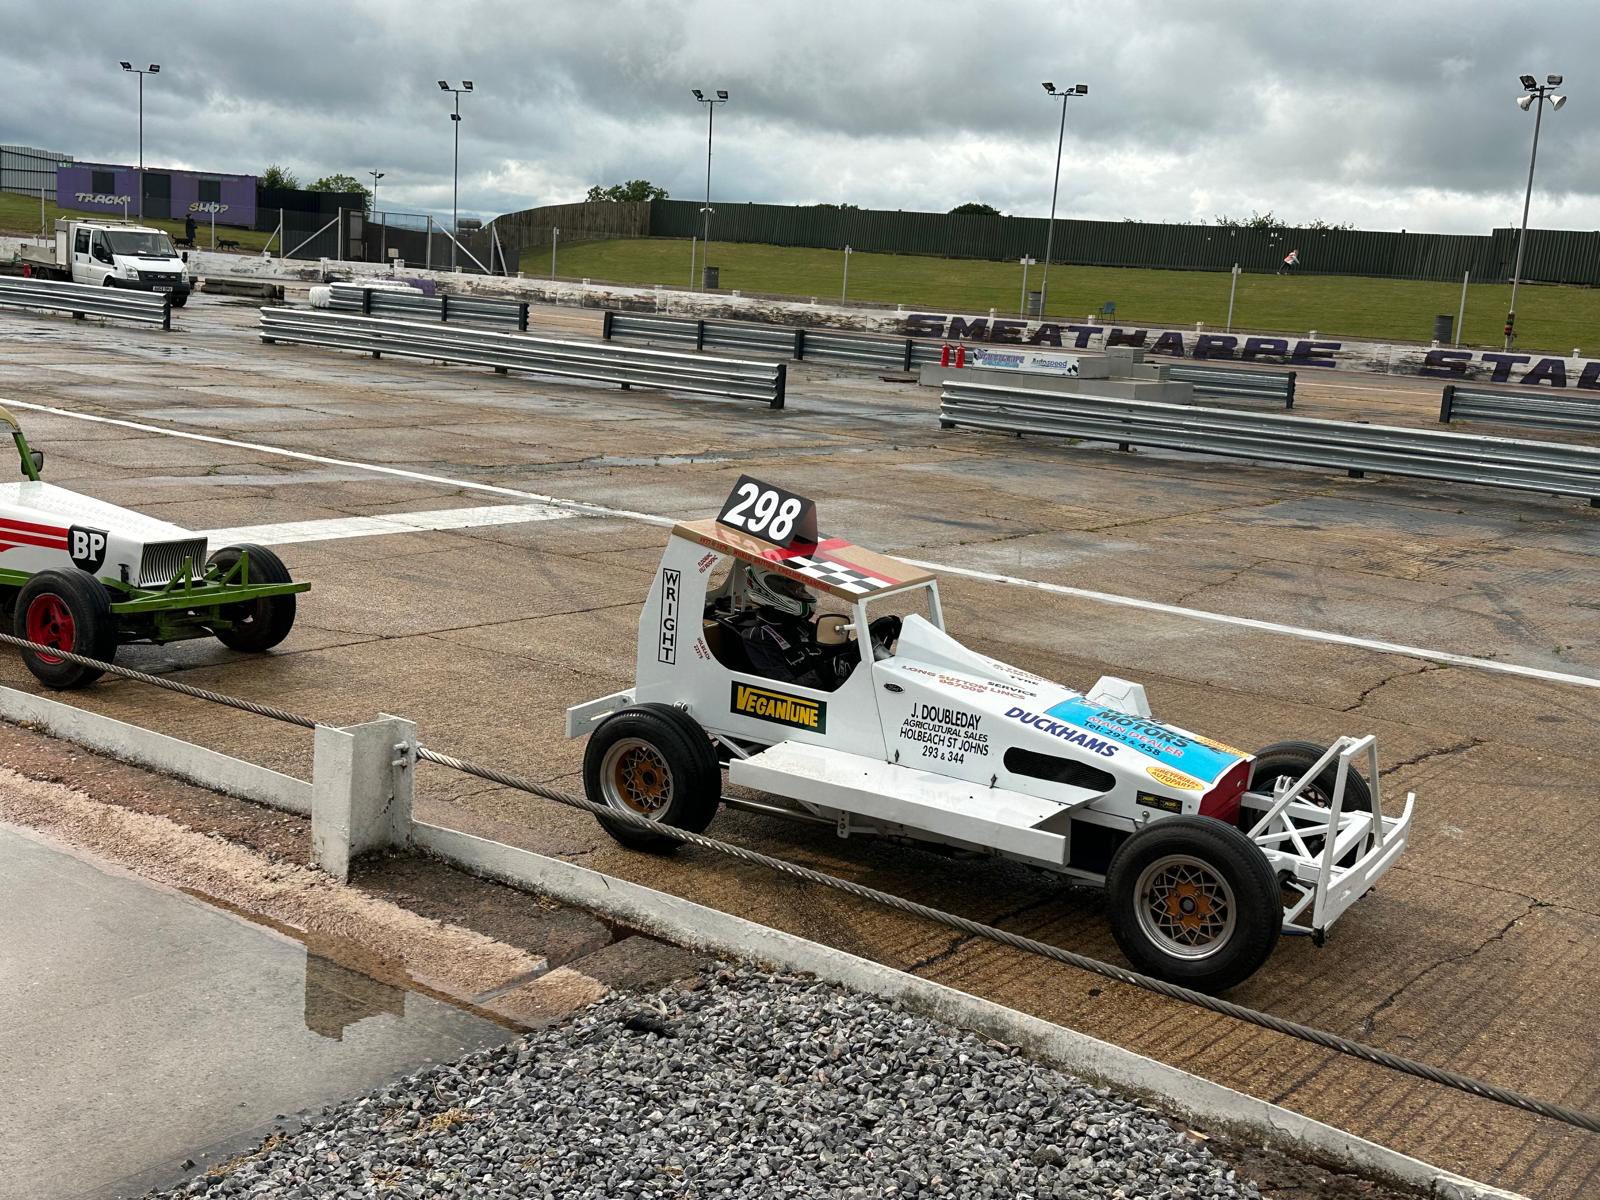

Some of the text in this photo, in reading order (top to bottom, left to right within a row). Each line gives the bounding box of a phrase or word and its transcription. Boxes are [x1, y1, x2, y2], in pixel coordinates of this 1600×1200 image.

[189, 202, 229, 213] SHOP
[722, 483, 802, 541] 298
[72, 530, 105, 562] BP
[661, 571, 680, 661] WRIGHT
[902, 665, 1026, 700] LONG SUTTON LINCS
[987, 681, 1037, 698] SERVICE
[903, 718, 988, 743] AGRICULTURAL SALES
[911, 702, 982, 731] J. DOUBLEDAY
[1004, 706, 1119, 757] DUCKHAMS
[1096, 711, 1188, 748] MOTORS
[900, 727, 989, 756] HOLBEACH ST JOHNS
[1083, 720, 1104, 732] Tel:
[1105, 729, 1127, 741] 293
[1138, 742, 1160, 756] 458
[1087, 716, 1126, 733] MAIN
[1128, 731, 1184, 757] DEALER
[922, 745, 965, 765] 293 & 344
